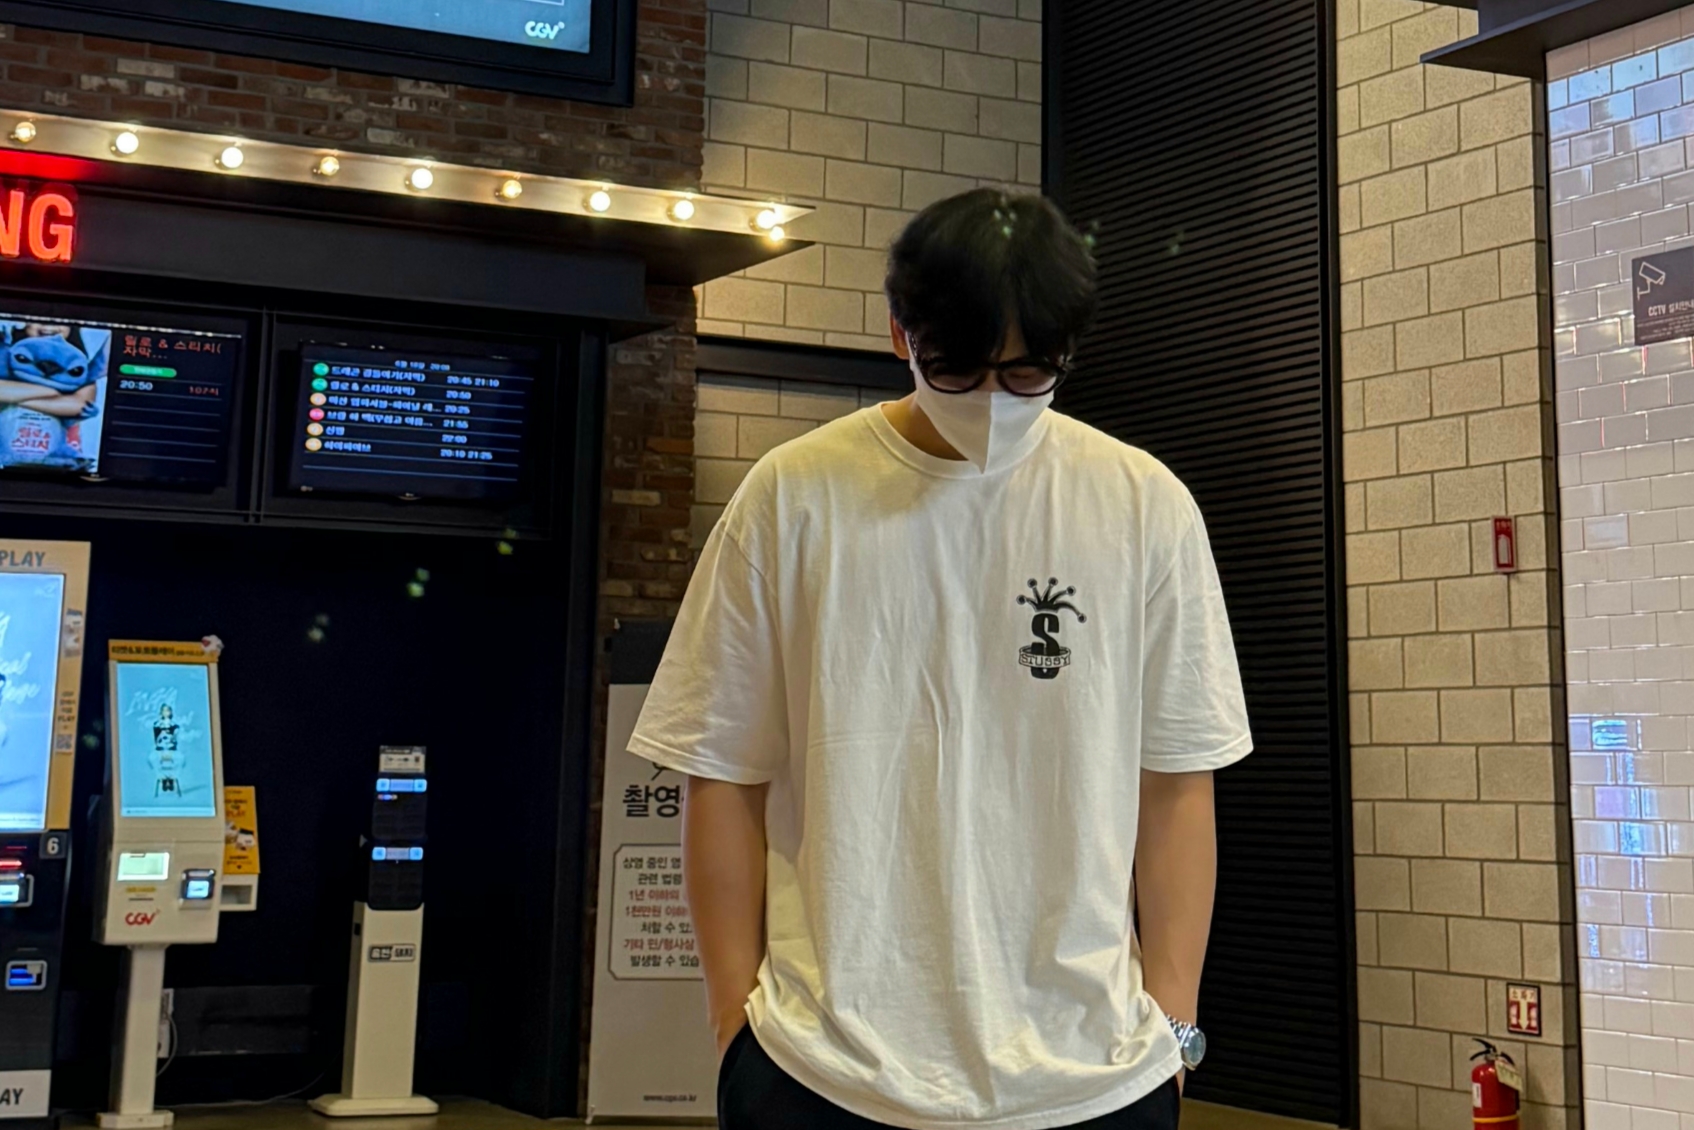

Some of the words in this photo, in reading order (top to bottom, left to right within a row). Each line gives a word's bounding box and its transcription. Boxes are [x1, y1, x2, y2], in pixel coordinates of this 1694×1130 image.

[525, 20, 559, 40] CGV
[1648, 304, 1666, 317] CCTV
[119, 380, 153, 391] 20:50
[474, 377, 500, 388] 21:10
[0, 551, 46, 567] PLAY
[622, 785, 684, 818] 촬영
[46, 837, 60, 854] 6
[623, 857, 643, 869] 상영
[638, 873, 658, 885] 관련
[629, 889, 645, 901] 1년
[125, 912, 155, 926] CGV
[664, 921, 676, 933] 수
[665, 954, 676, 967] 수
